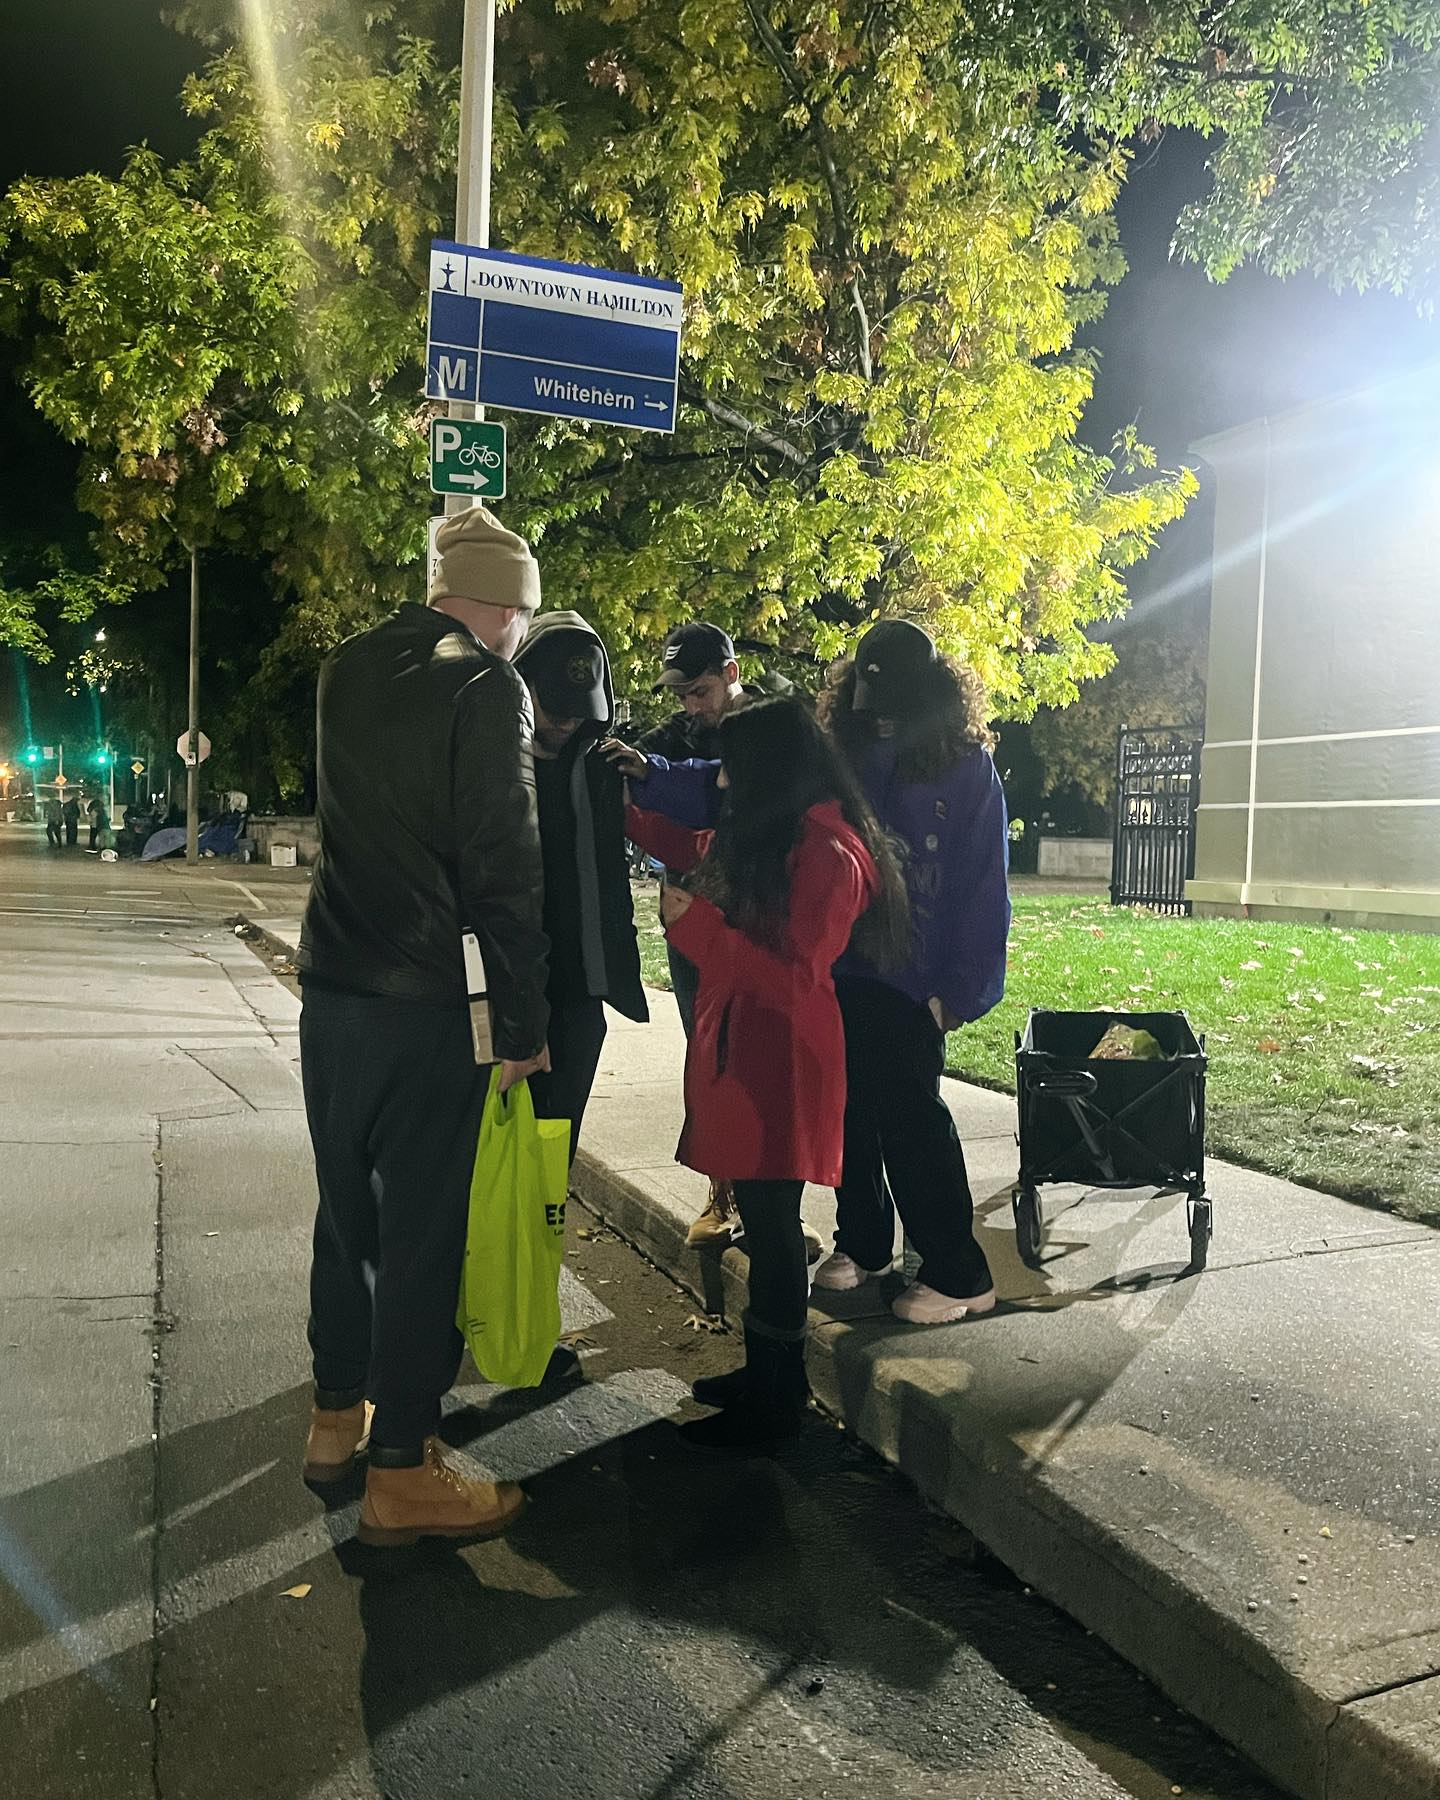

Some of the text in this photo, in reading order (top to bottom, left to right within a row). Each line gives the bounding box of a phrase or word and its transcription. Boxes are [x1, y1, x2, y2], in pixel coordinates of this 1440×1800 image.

[478, 271, 674, 319] DOWNTOWN HAMILTON
[438, 355, 467, 391] M
[534, 376, 635, 411] Whitehern
[435, 424, 462, 463] P
